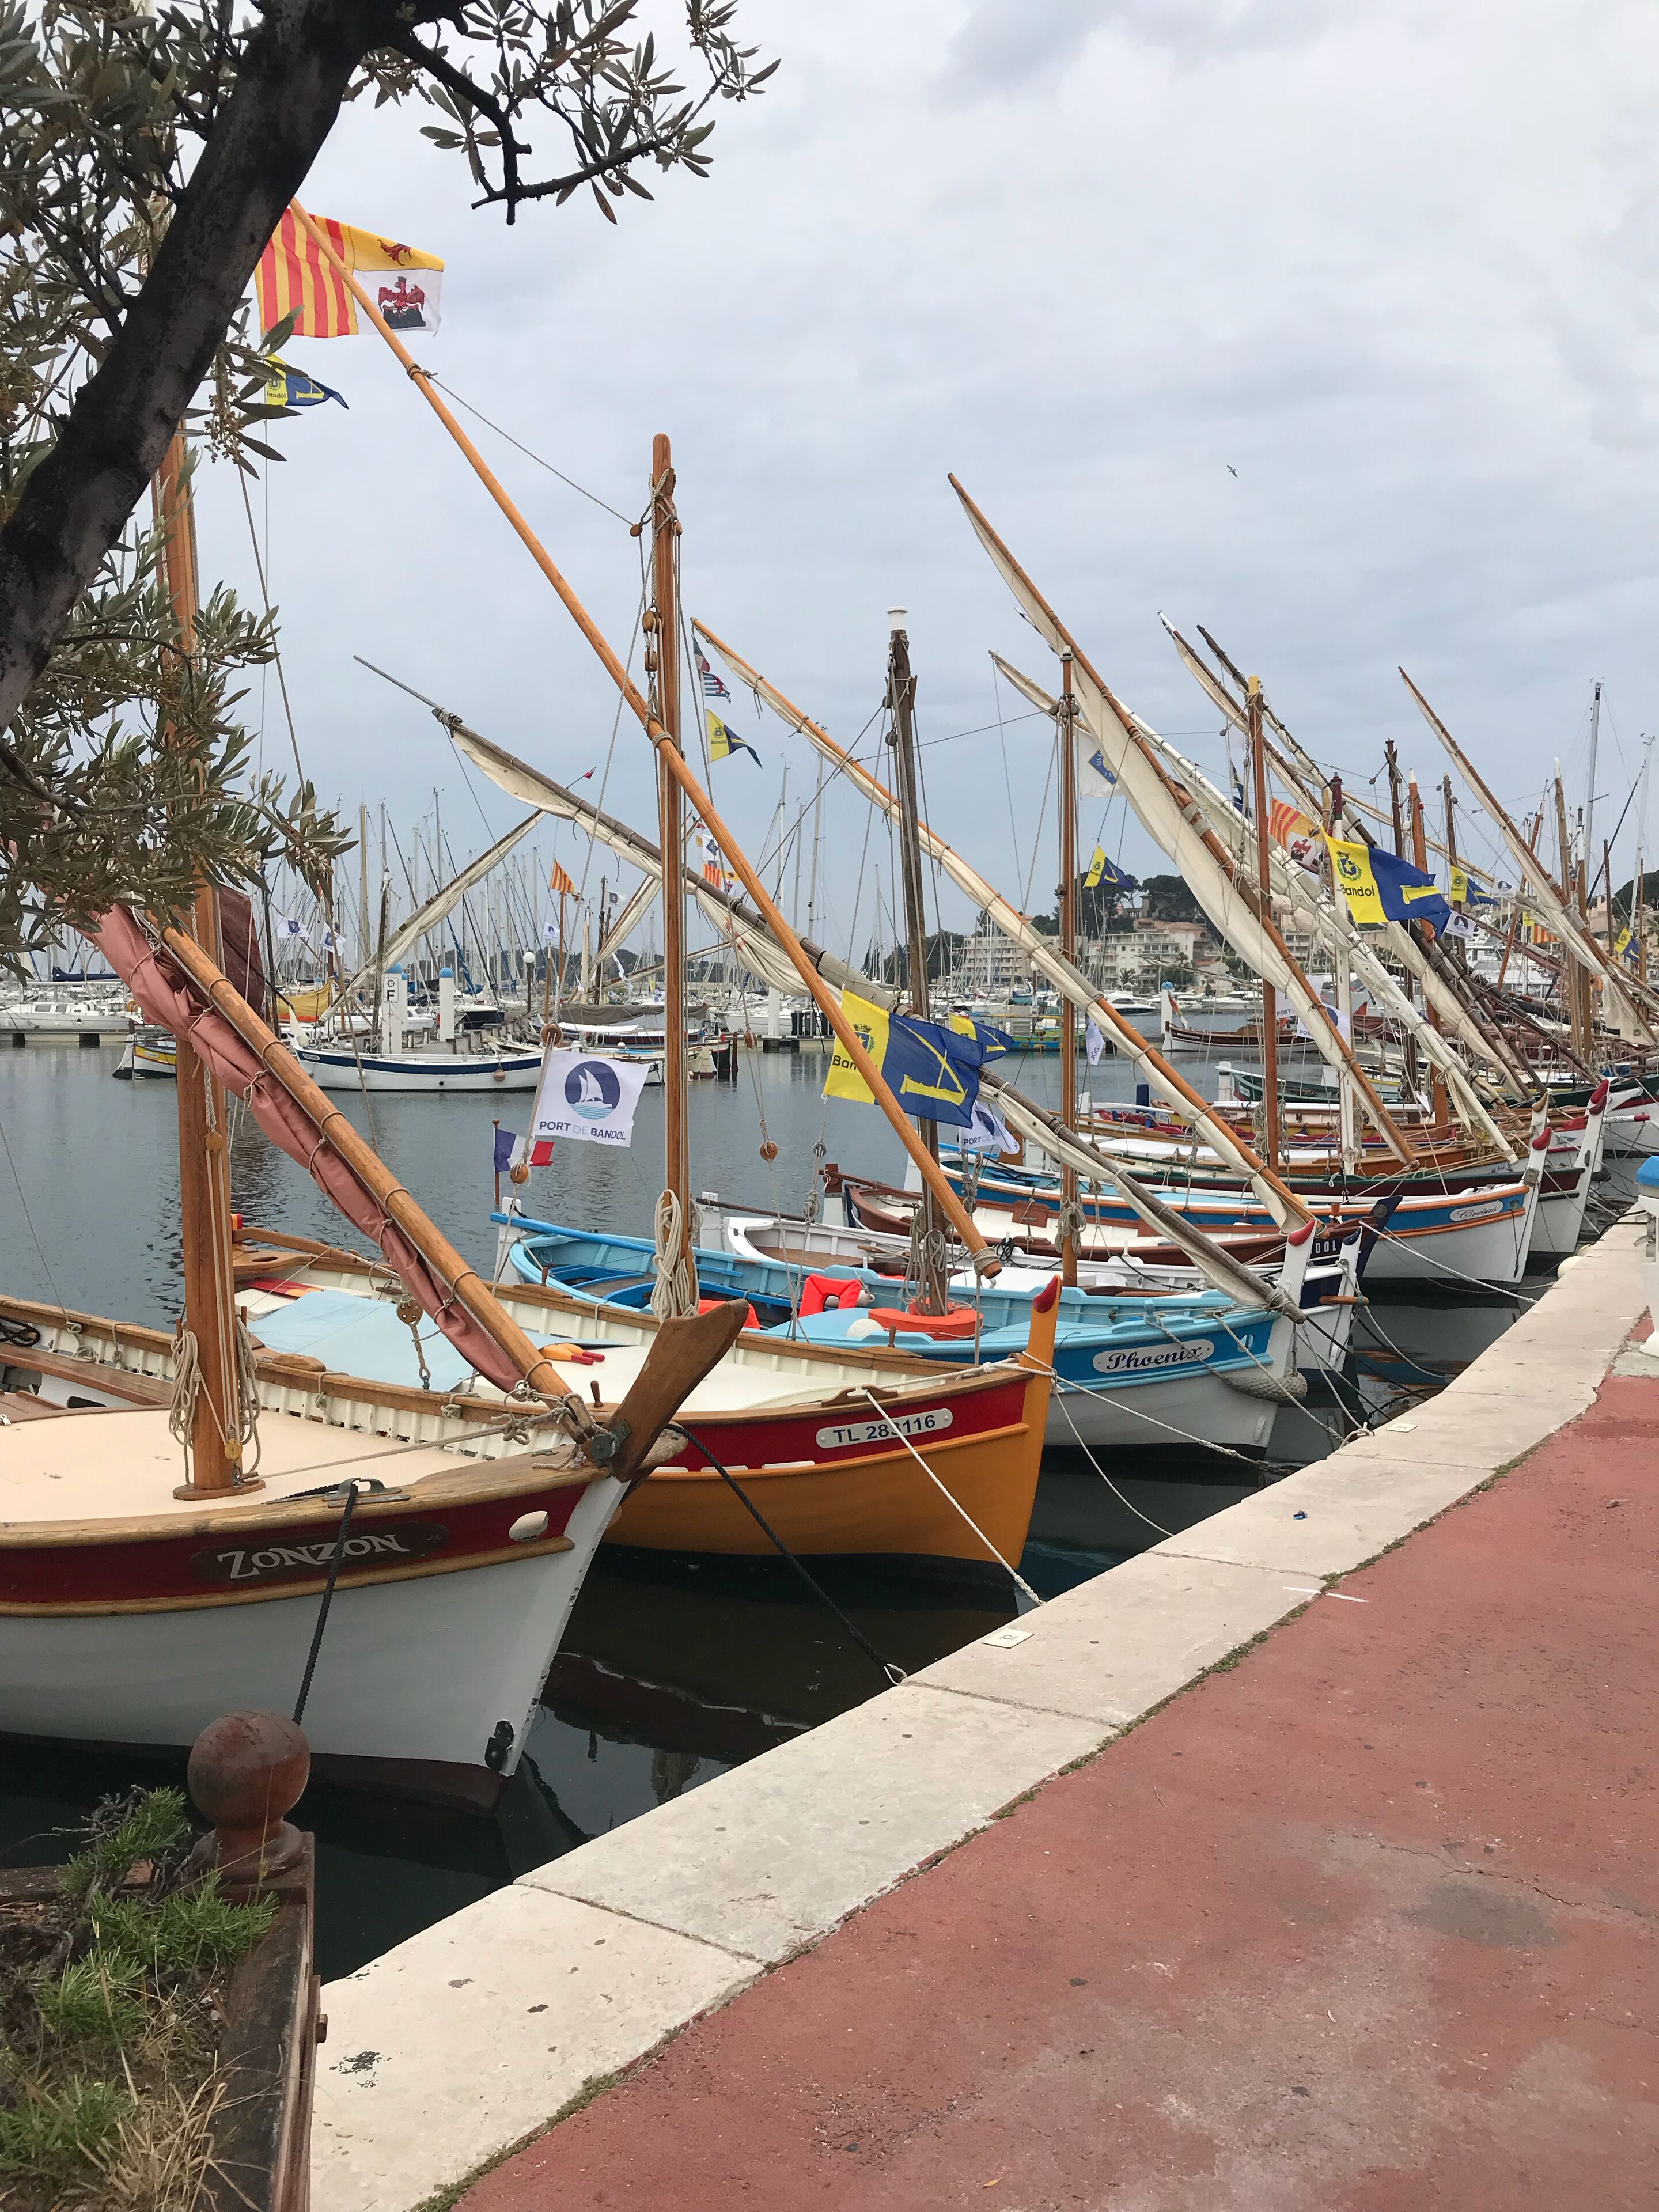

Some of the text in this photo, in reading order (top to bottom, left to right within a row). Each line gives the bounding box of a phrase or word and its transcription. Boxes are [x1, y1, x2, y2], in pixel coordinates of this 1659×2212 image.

[387, 990, 395, 1001] F
[540, 1121, 626, 1141] PORT DE BANDOL
[963, 1136, 982, 1145] PORT
[1315, 1240, 1337, 1253] DOL
[1106, 1346, 1203, 1370] Phoenix
[833, 1429, 860, 1443] TL
[217, 1534, 411, 1579] ZONZON
